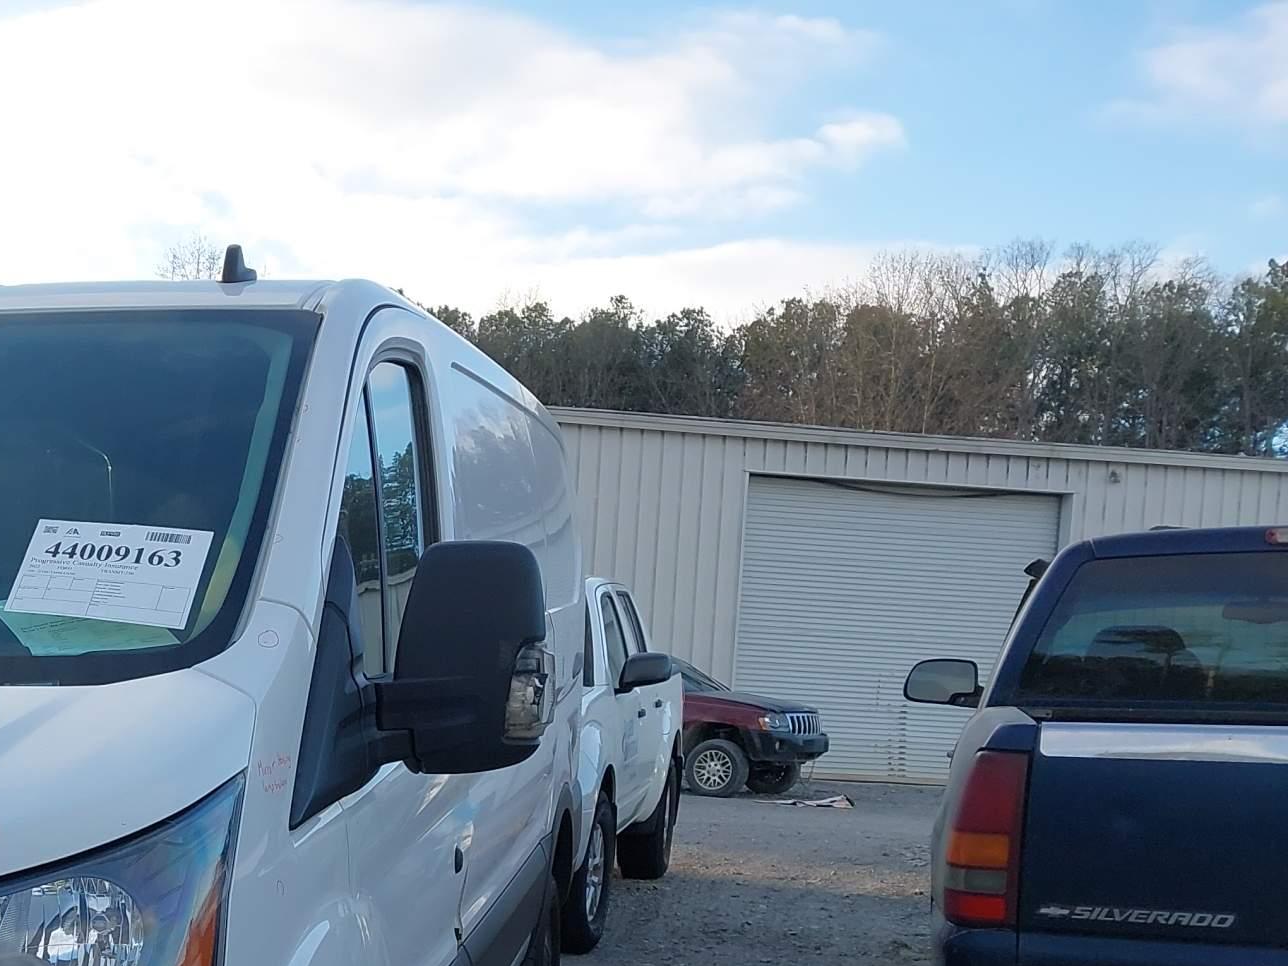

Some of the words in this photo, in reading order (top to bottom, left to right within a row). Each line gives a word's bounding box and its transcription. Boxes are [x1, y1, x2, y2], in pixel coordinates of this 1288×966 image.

[30, 557, 71, 566] Progressive
[72, 560, 103, 569] Casualty
[104, 562, 140, 571] Insurance
[44, 541, 183, 568] 44009163
[1071, 906, 1236, 928] SILVERADO
